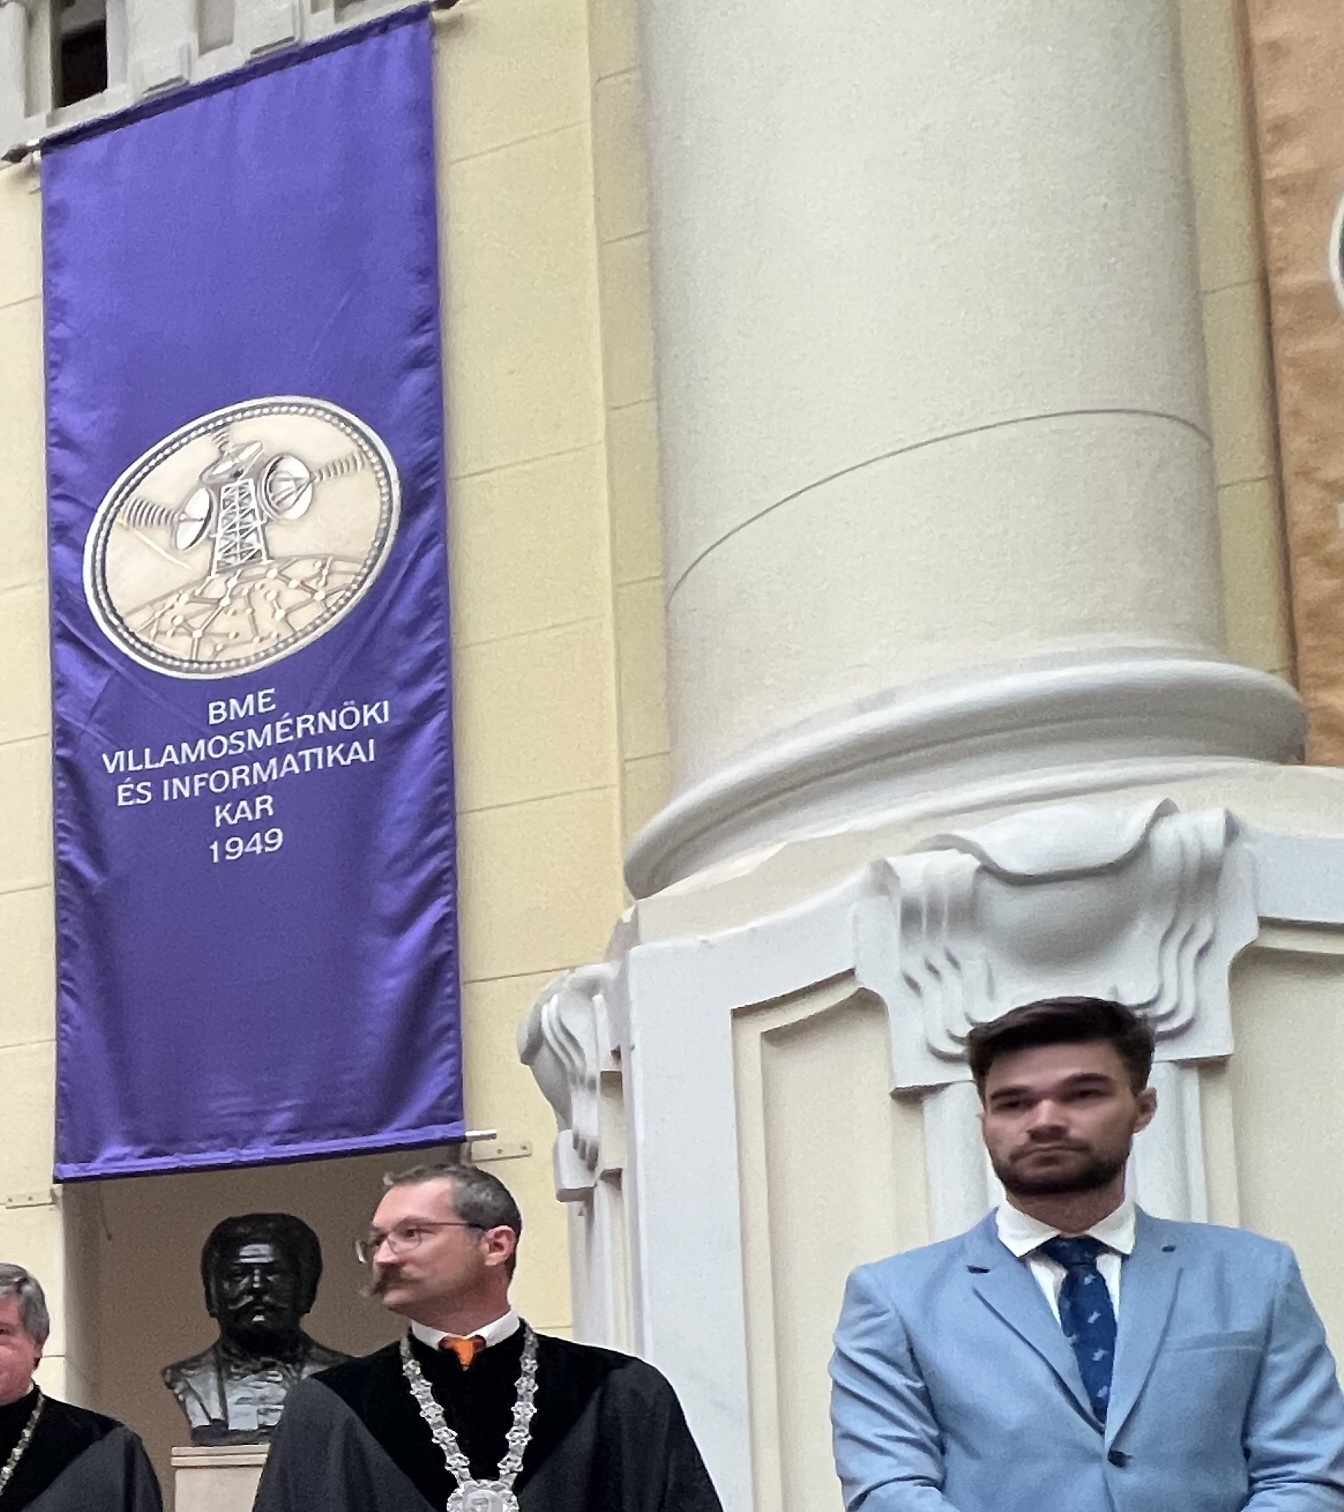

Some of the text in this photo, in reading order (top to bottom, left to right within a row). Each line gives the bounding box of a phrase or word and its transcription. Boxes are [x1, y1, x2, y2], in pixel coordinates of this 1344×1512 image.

[208, 688, 276, 725] BME
[102, 700, 390, 774] VILLAMOSMÉRNÖKI
[117, 739, 375, 806] ÉS INFORMATIKAI
[214, 795, 274, 828] KAR
[209, 828, 284, 863] 1949
